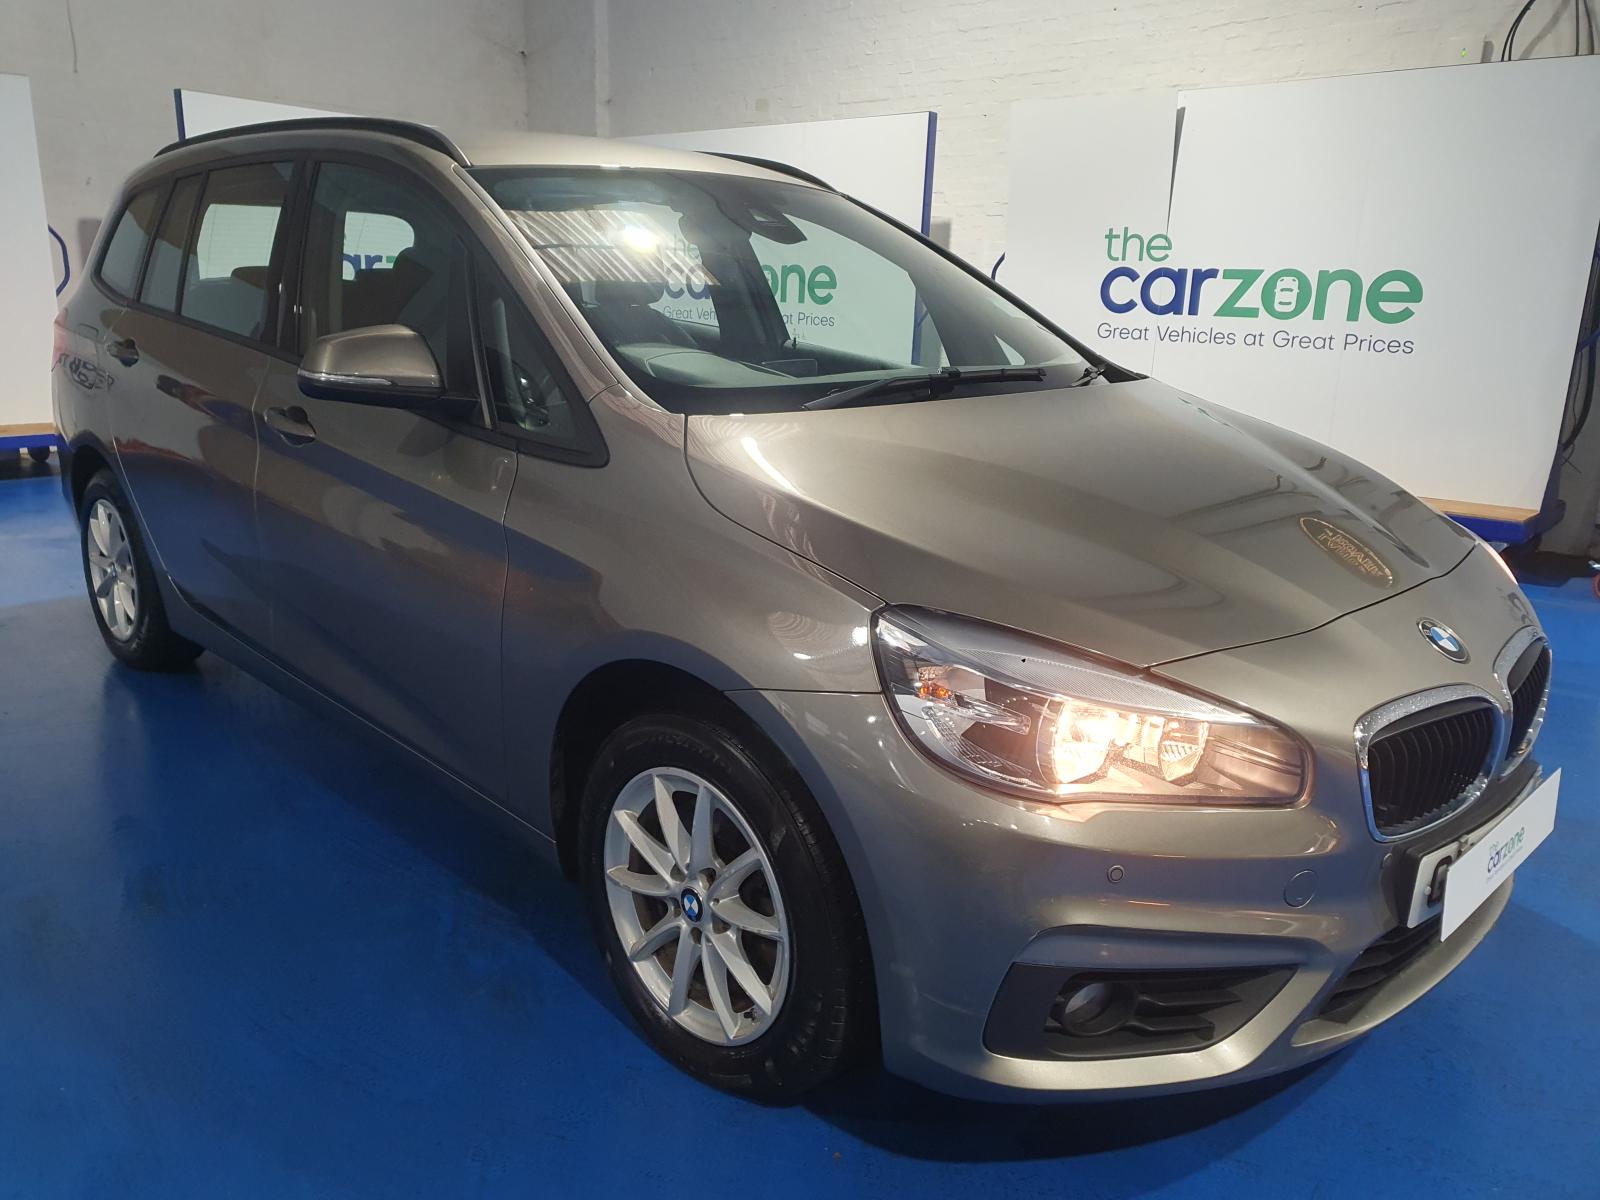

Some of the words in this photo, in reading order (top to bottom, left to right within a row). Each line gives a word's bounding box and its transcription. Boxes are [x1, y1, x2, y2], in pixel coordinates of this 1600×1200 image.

[1104, 226, 1173, 262] the
[1099, 266, 1424, 324] carzone
[663, 305, 693, 320] Great
[797, 311, 836, 327] Prices
[1096, 322, 1150, 341] Great
[1156, 325, 1237, 346] Vehicles
[1243, 331, 1265, 347] at
[1272, 329, 1336, 351] Great
[1343, 333, 1415, 355] Prices
